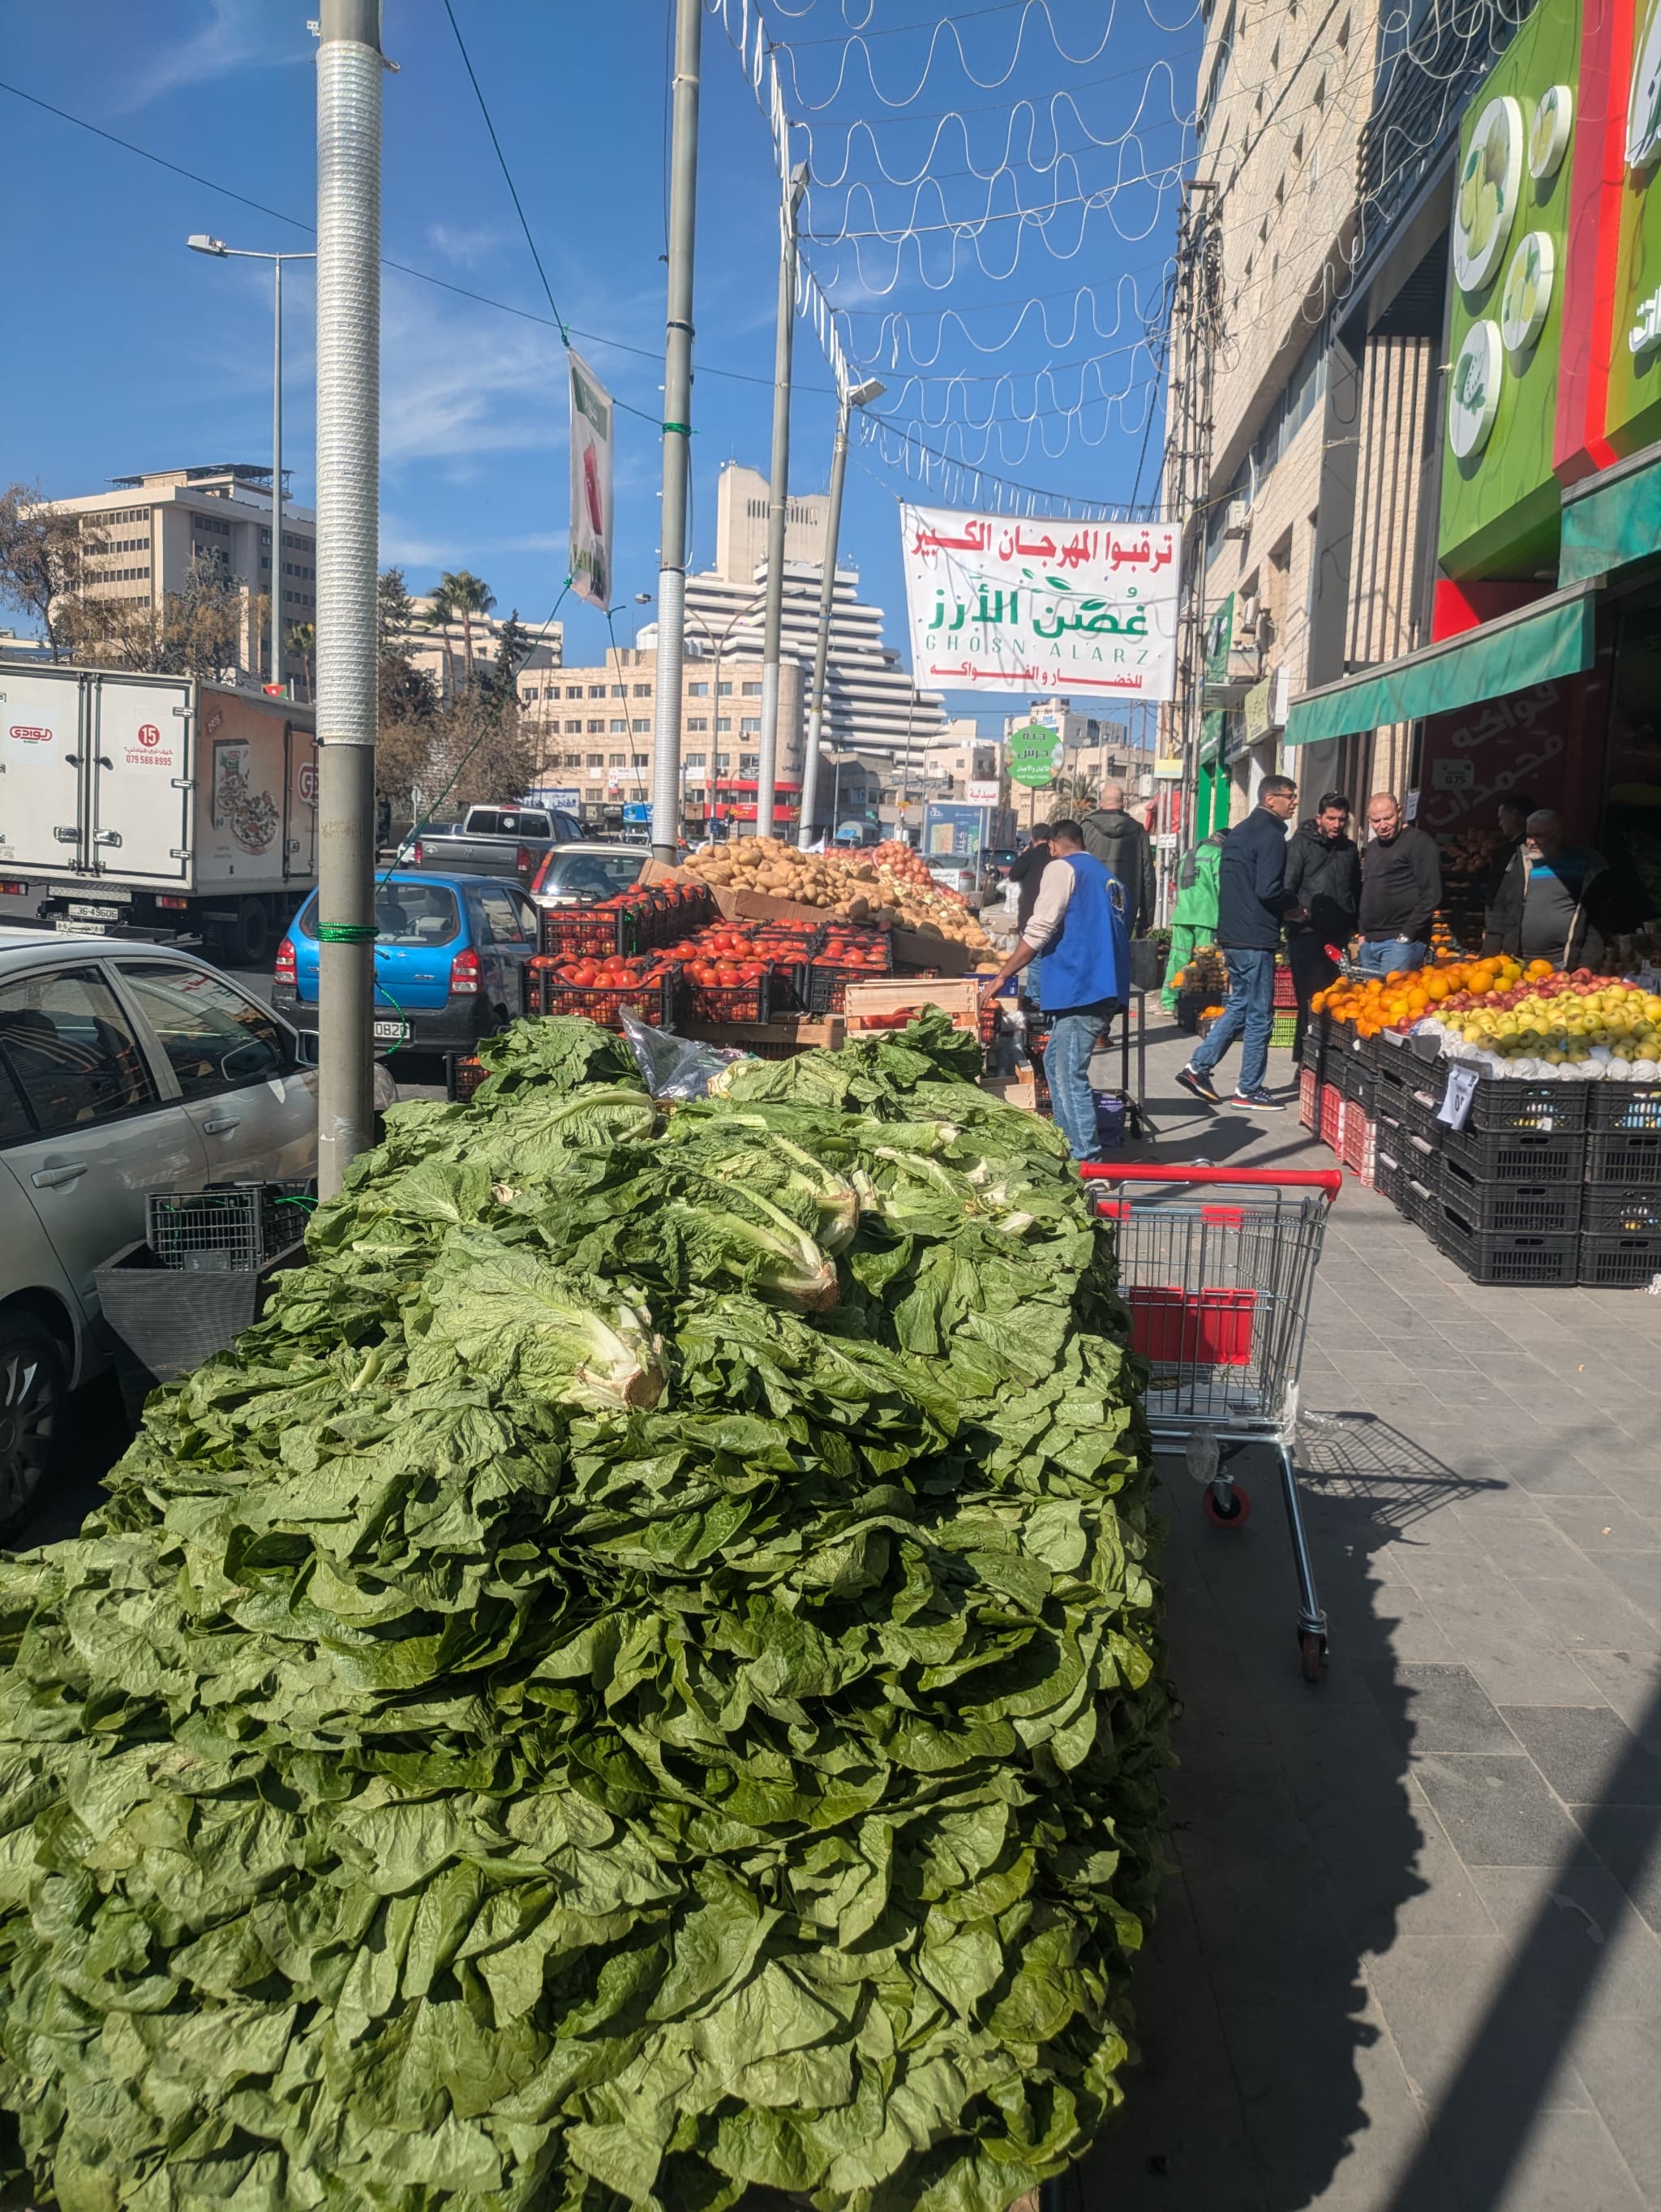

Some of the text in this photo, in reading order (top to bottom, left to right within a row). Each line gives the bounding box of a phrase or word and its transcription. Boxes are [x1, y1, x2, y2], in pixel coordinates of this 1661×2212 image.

[910, 520, 1173, 573] ترقبوا المهرجان الكبير
[925, 634, 1149, 665] GHOSN ALARZ
[140, 726, 157, 745] 15
[126, 754, 139, 764] 079
[139, 755, 153, 765] 588
[969, 788, 997, 801] صيدلية
